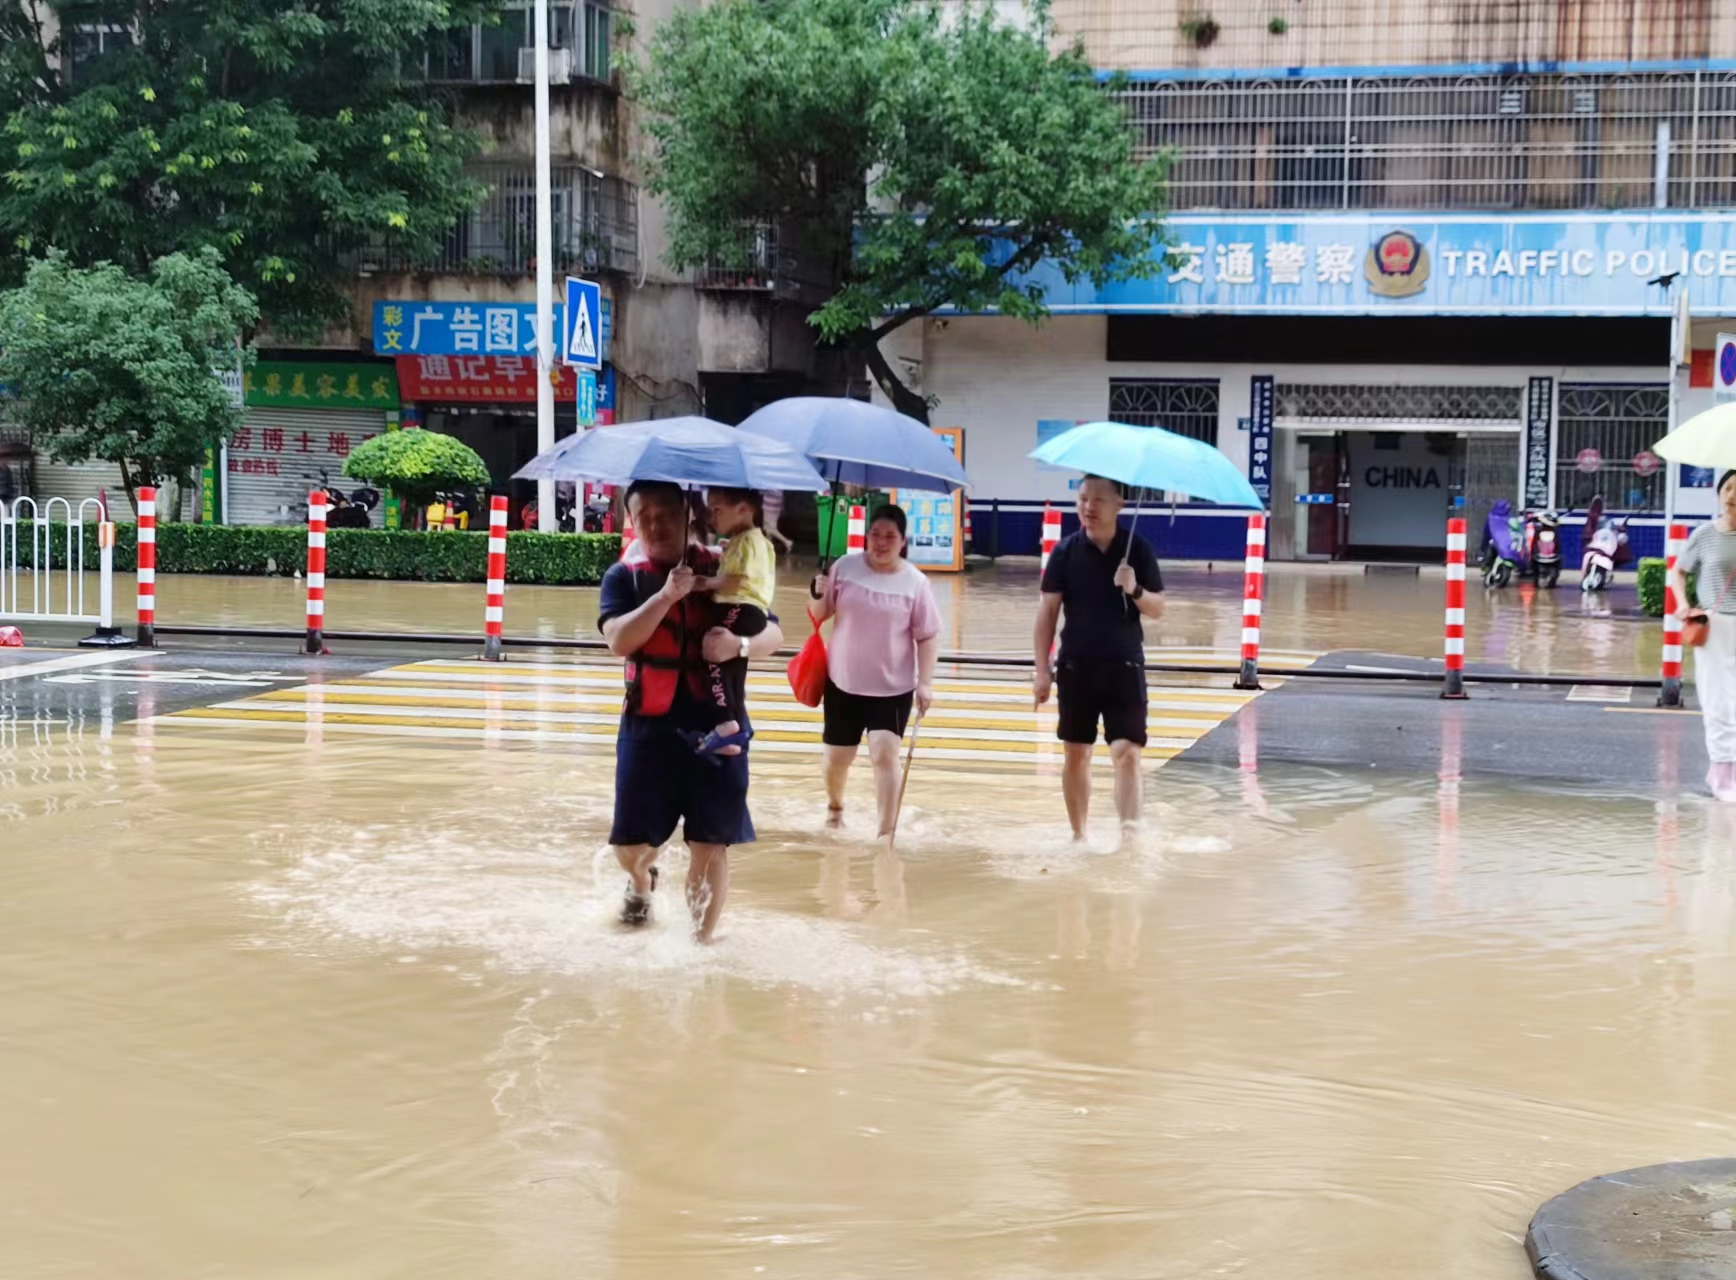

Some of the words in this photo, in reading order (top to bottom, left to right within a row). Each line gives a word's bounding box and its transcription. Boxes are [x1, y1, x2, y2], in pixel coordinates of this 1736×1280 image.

[1167, 242, 1355, 284] 交通警察
[1443, 250, 1594, 277] TRAFFIC
[1606, 250, 1736, 277] POLICE
[383, 306, 403, 350] 彩文
[419, 354, 564, 382] 通记早
[230, 427, 377, 456] 房博士地
[1364, 465, 1441, 489] CHINA
